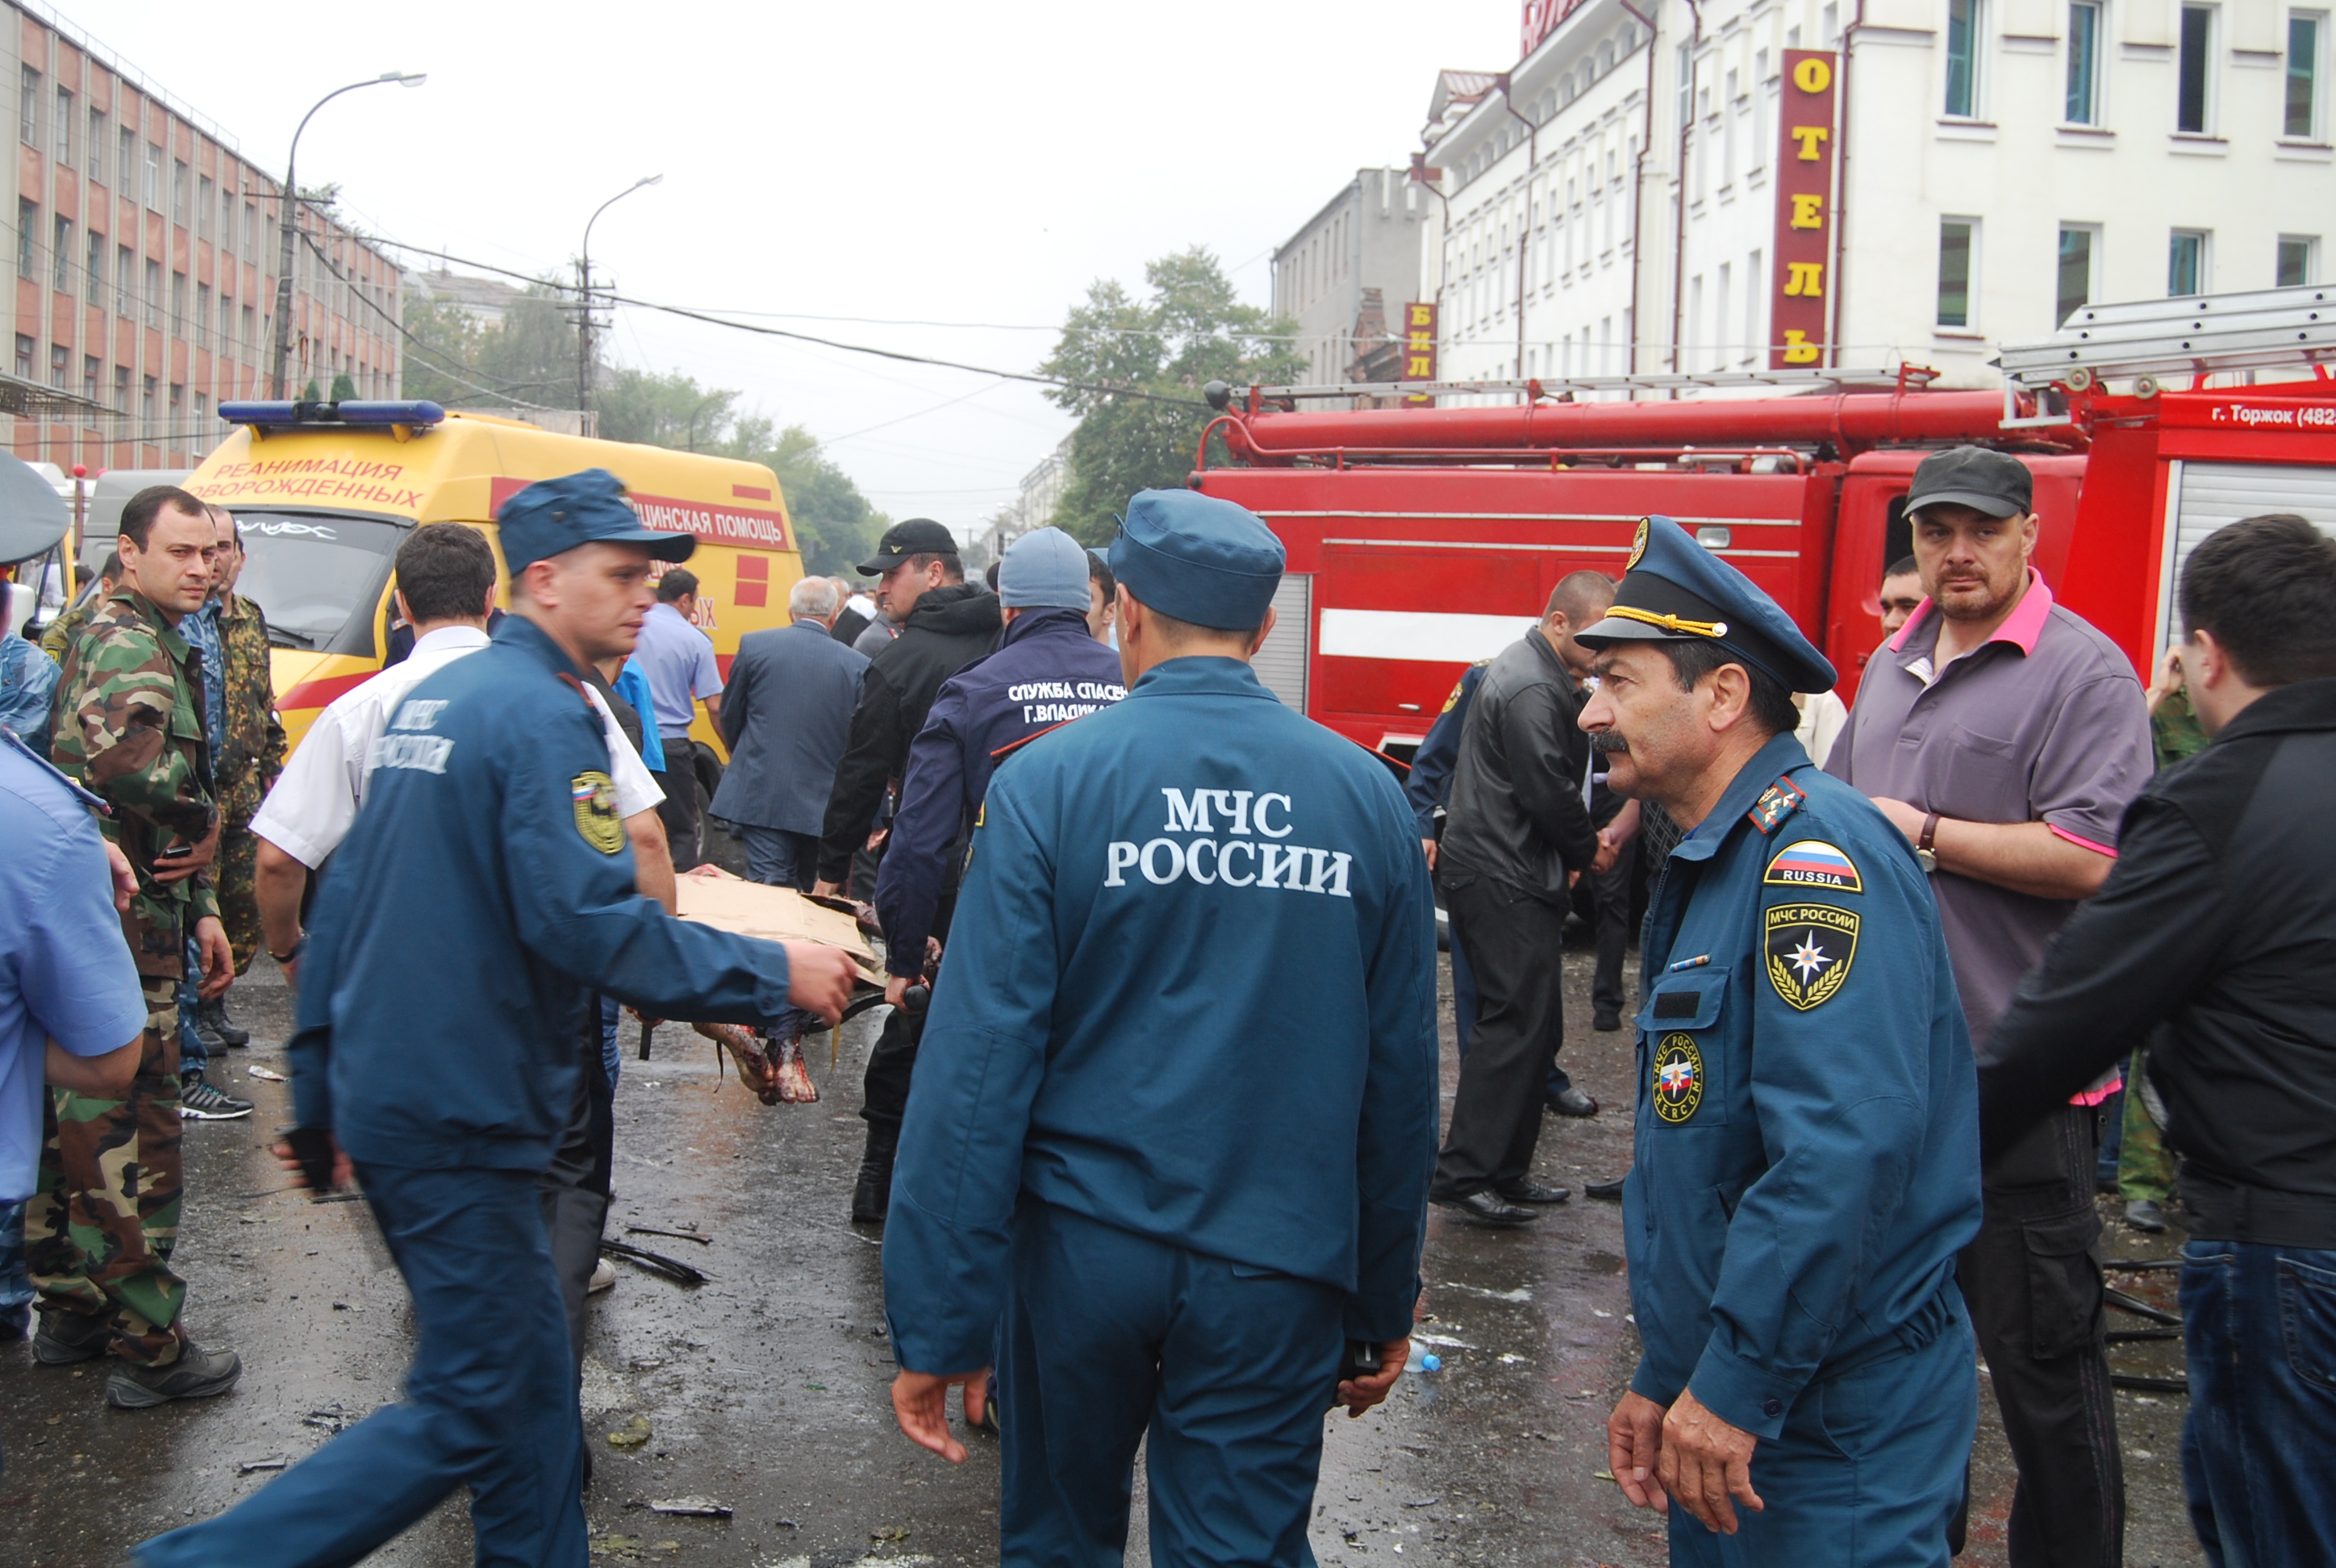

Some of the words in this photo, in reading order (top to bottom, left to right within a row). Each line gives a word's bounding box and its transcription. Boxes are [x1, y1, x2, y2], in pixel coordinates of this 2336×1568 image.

[1783, 57, 1831, 364] ОТЕЛЬ
[1408, 306, 1432, 409] БИЛ
[2230, 404, 2293, 427] Торжок
[2297, 407, 2336, 427] (482
[213, 459, 403, 481] РЕАНИМАЦИЯ
[714, 513, 782, 544] ПОМОЩЬ
[1008, 682, 1075, 702] СЛУЖБА
[1076, 682, 1129, 701] СПАСЕН
[1161, 787, 1294, 839] МЧС
[1103, 837, 1353, 898] РОССИИ
[1783, 869, 1842, 886] RUSSIA
[1770, 909, 1798, 924] МЧС
[1800, 908, 1855, 930] РОССИИ
